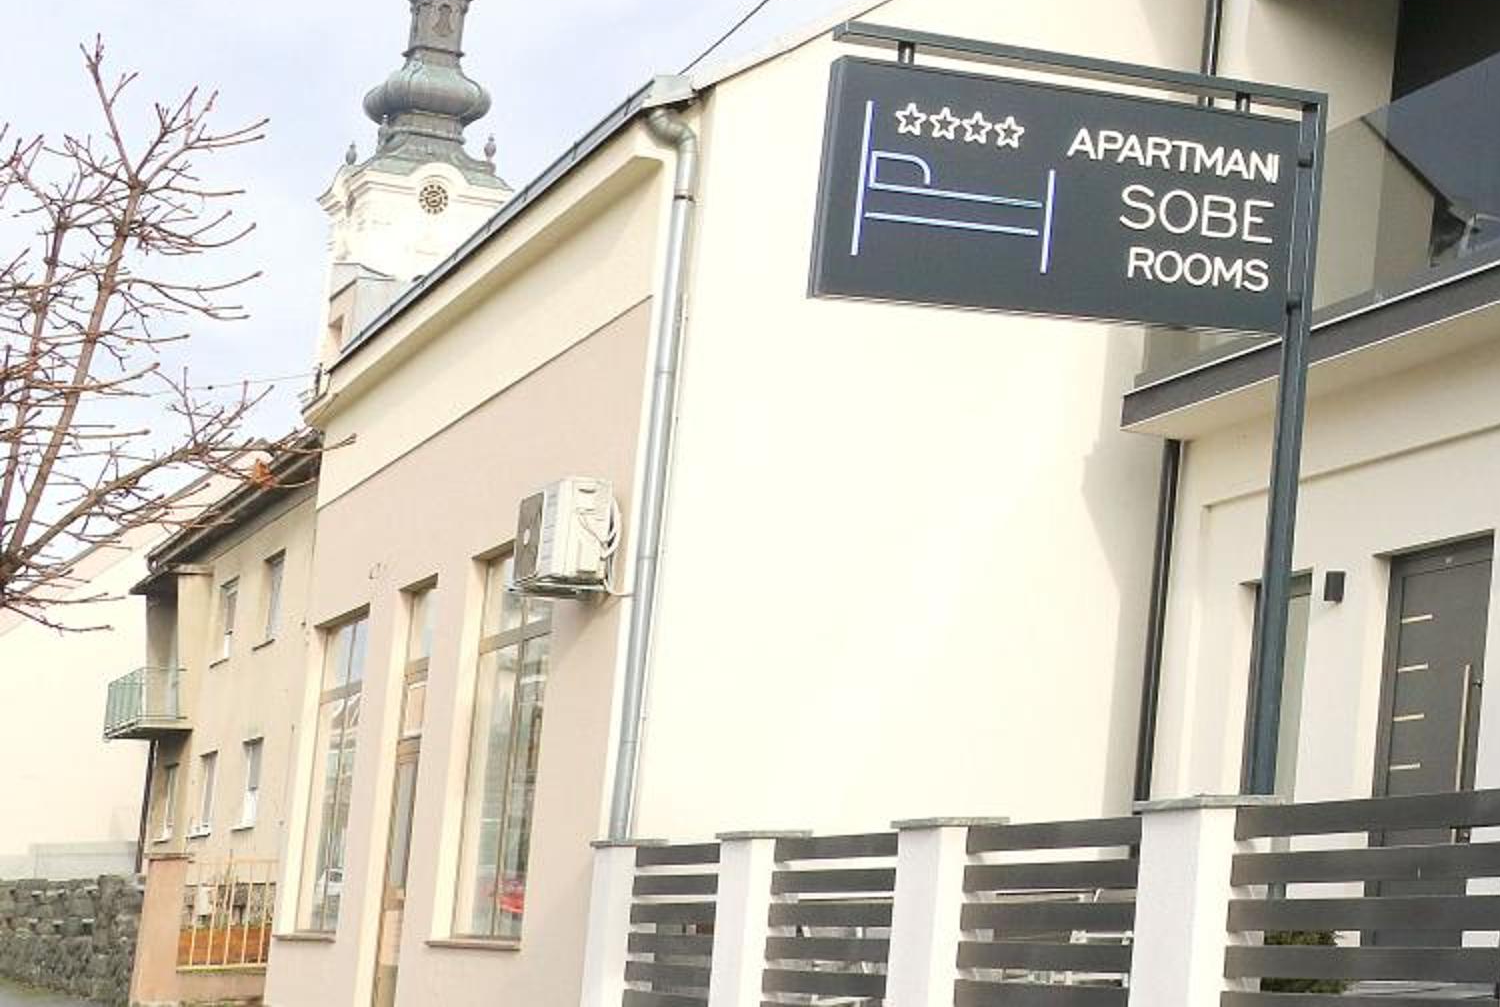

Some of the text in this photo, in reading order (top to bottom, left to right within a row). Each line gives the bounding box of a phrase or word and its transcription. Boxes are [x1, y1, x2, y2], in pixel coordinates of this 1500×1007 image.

[1067, 127, 1280, 184] APARTMANI
[1119, 184, 1275, 244] SOBE
[1127, 246, 1270, 292] ROOMS
